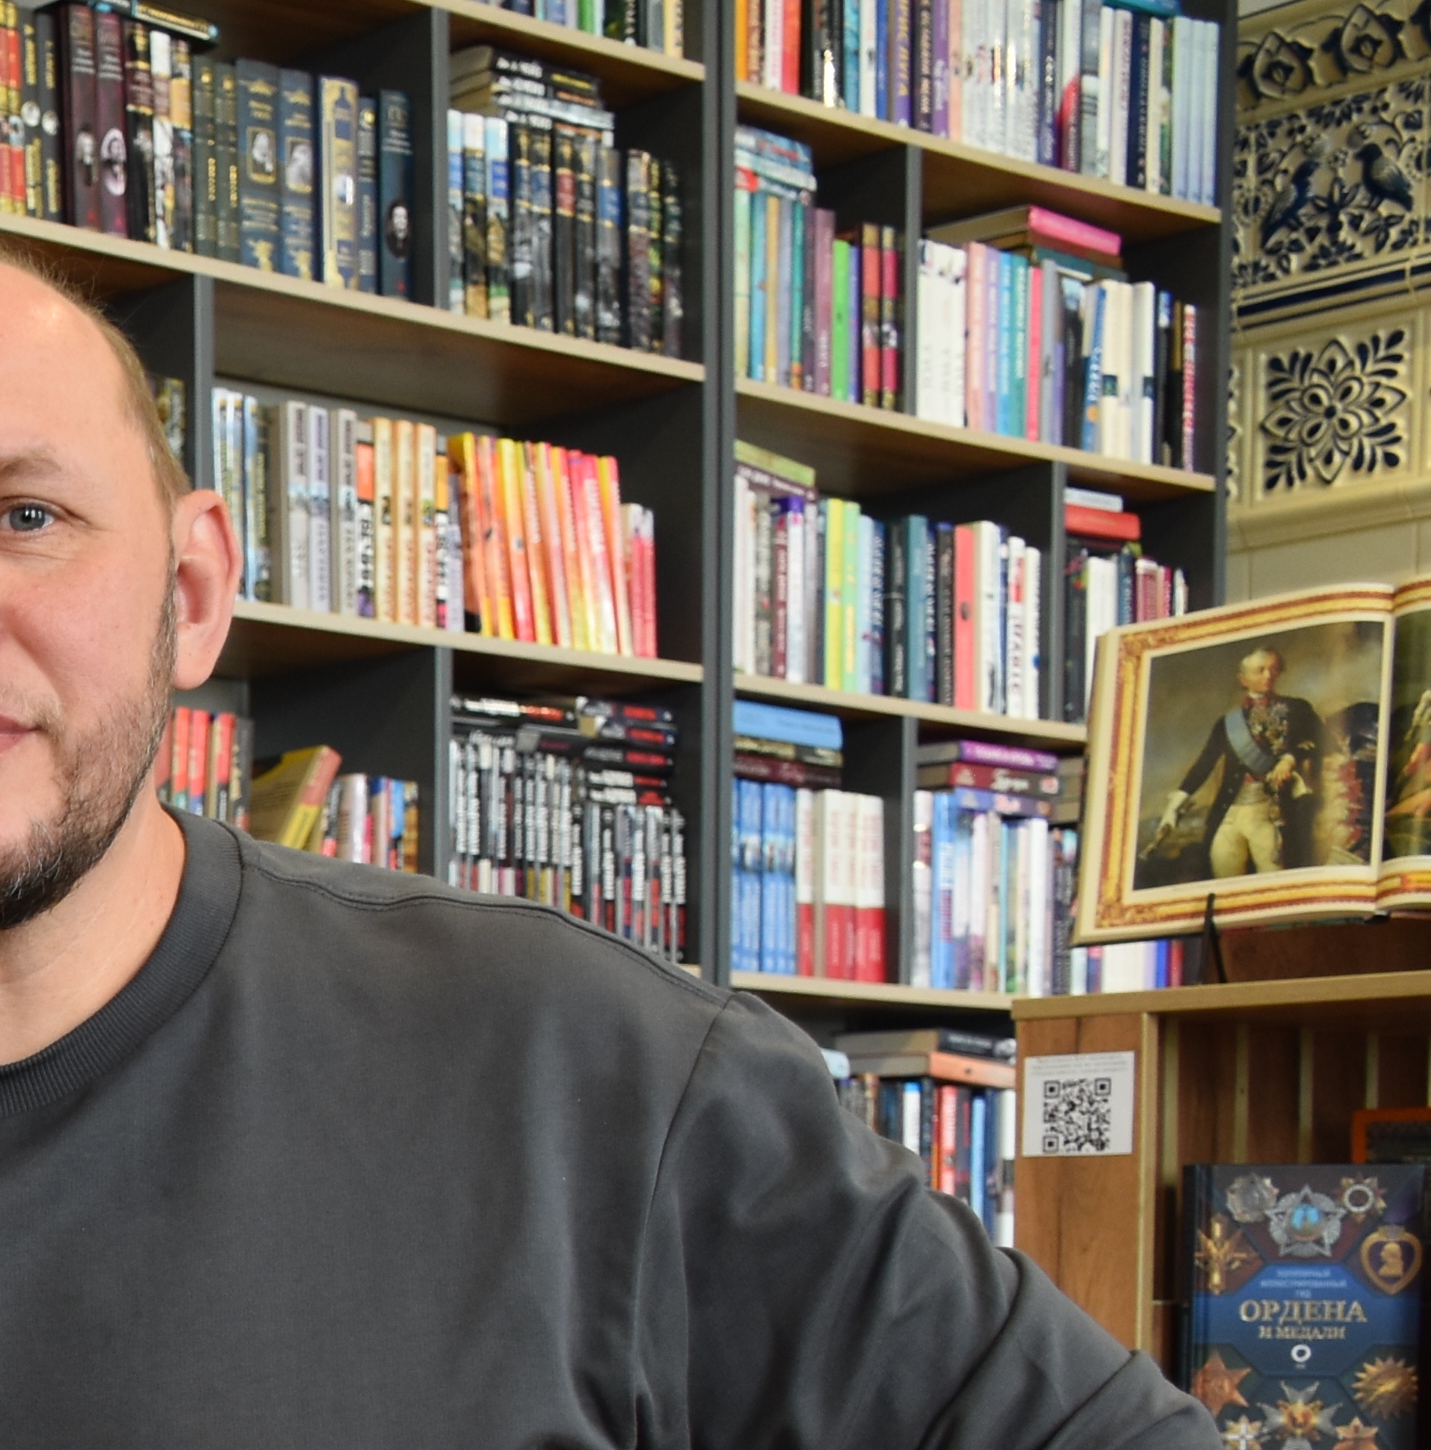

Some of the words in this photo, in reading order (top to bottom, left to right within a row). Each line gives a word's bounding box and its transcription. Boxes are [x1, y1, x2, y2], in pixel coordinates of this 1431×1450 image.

[1239, 1300, 1368, 1324] ОРДЕНА
[1258, 1326, 1272, 1339] И
[1275, 1326, 1346, 1340] МЕДАЛИ
